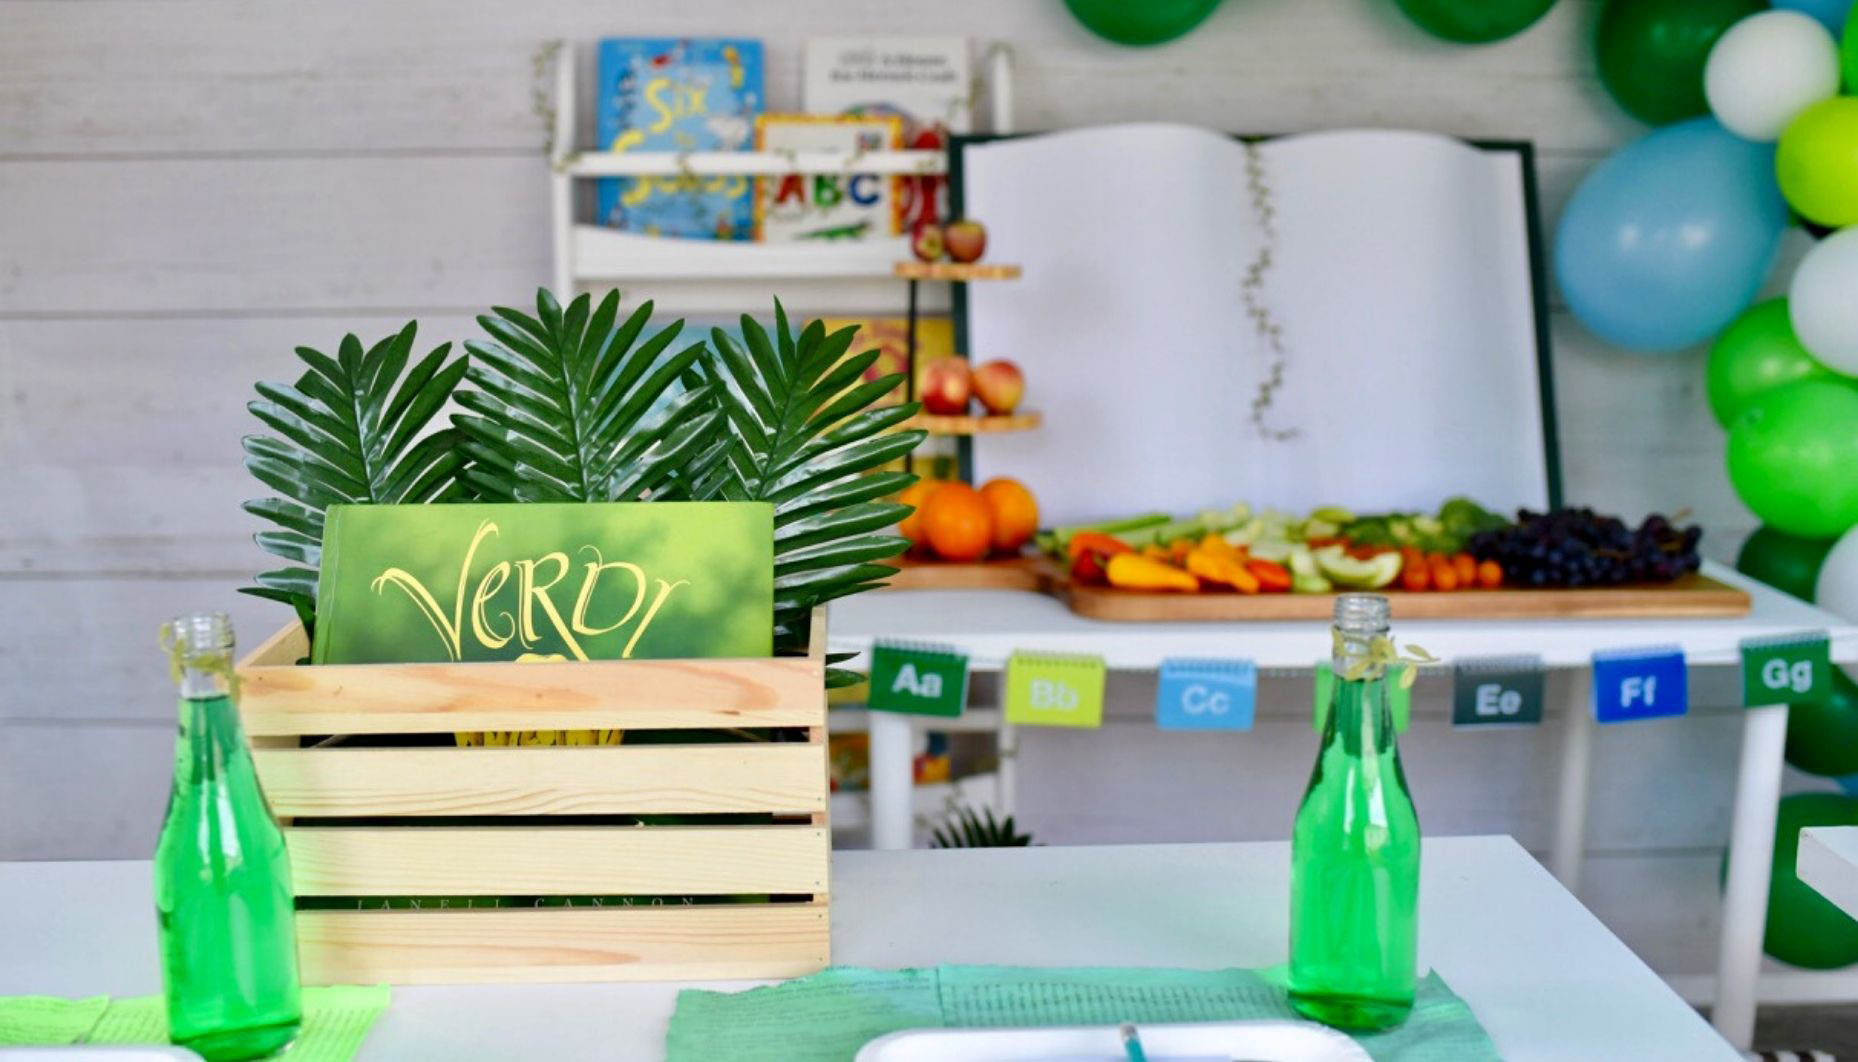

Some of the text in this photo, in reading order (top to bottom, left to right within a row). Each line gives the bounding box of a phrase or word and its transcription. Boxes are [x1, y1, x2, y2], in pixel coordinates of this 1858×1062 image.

[774, 172, 881, 207] ABC
[891, 663, 943, 699] Aa
[1619, 675, 1657, 709] Ff
[1761, 657, 1813, 694] Gg
[1028, 677, 1079, 711] Bb
[1180, 684, 1231, 717] Cc
[1475, 682, 1523, 717] Ee
